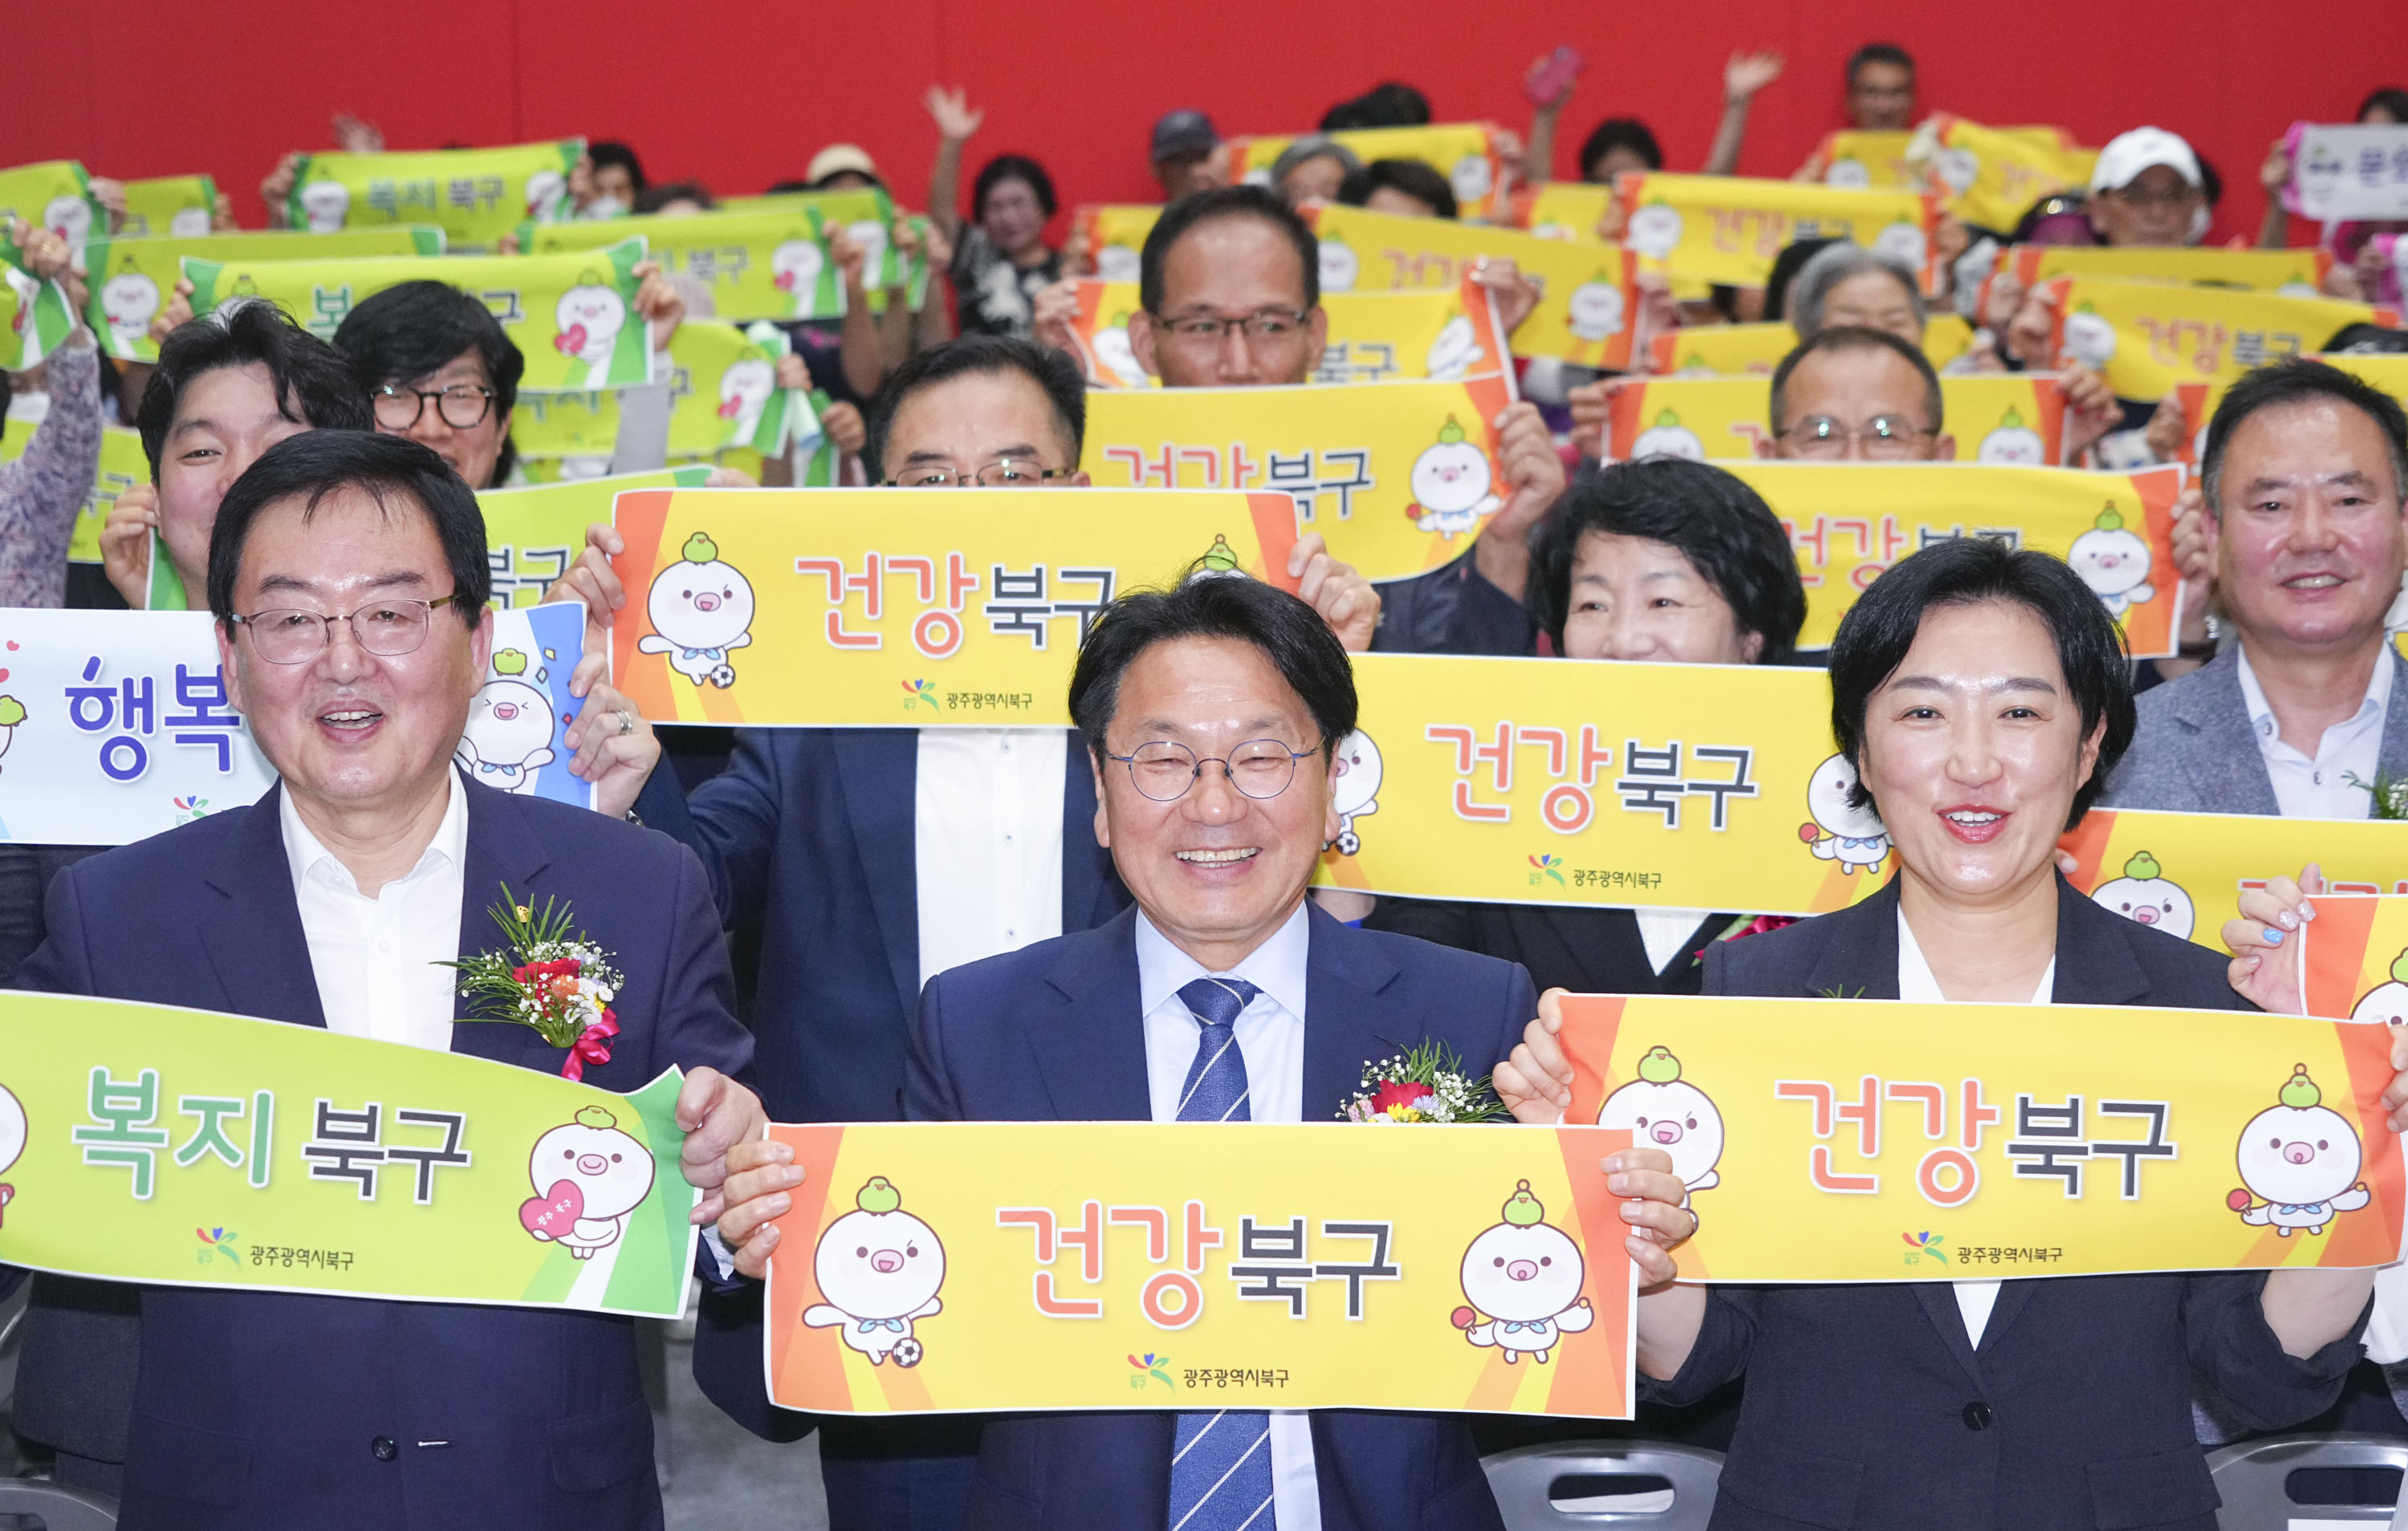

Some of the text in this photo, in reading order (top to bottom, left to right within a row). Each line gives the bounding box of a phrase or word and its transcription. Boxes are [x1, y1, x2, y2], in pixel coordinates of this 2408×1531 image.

[449, 174, 505, 213] 북구
[798, 554, 1116, 656] 건강 북구
[65, 656, 240, 782] 행복
[946, 692, 1033, 710] 광주광역시북구
[1426, 724, 1756, 832] 건강 북구
[1573, 869, 1662, 889] 광주광역시북구
[75, 1069, 470, 1203] 복지 북구
[1776, 1077, 2175, 1205] 건강 북구
[250, 1245, 354, 1271] 광주광역시북구
[998, 1201, 1399, 1328] 건강 북구
[1957, 1247, 2064, 1265] 광주광역시북구
[1183, 1369, 1290, 1388] 광주광역시북구
